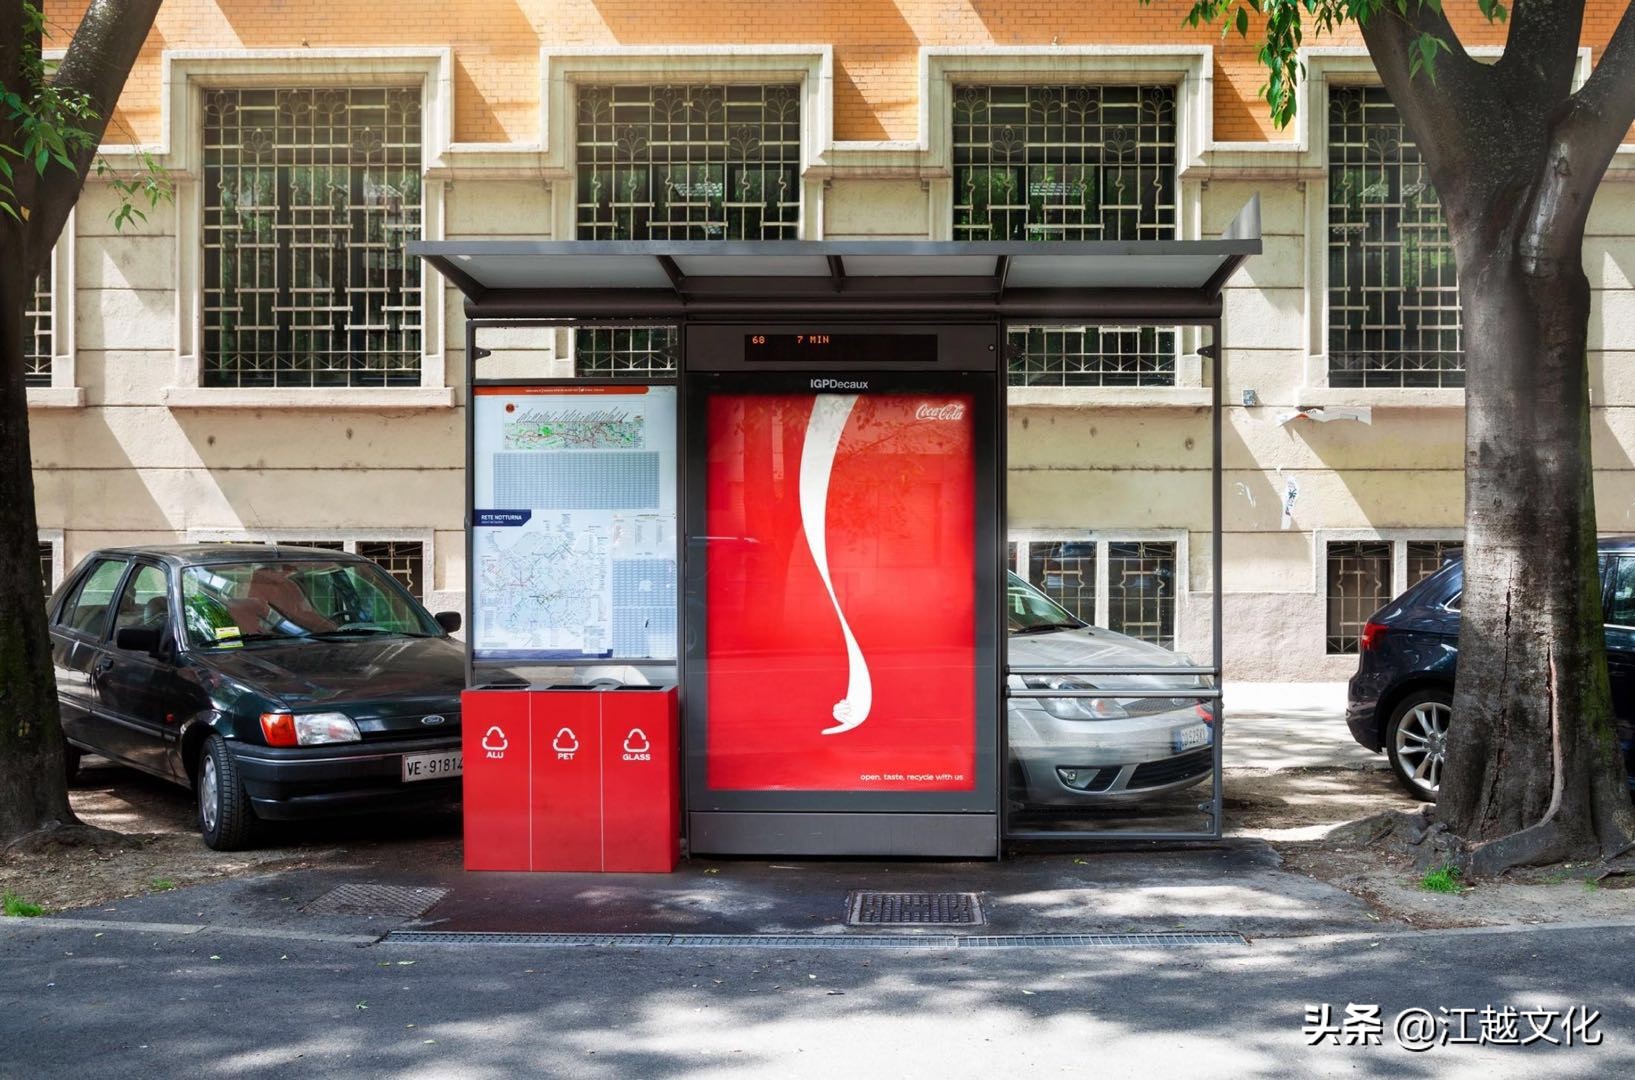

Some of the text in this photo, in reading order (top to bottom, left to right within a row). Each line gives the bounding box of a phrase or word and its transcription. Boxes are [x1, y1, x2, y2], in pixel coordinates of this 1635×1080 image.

[752, 335, 829, 344] 68 7 MIN
[810, 379, 869, 390] IGPDecaux
[915, 402, 965, 421] Coca-Cola
[486, 751, 504, 759] ALU
[557, 752, 576, 760] PET
[622, 753, 651, 761] GLASS
[906, 773, 934, 782] recycle
[935, 773, 953, 782] with
